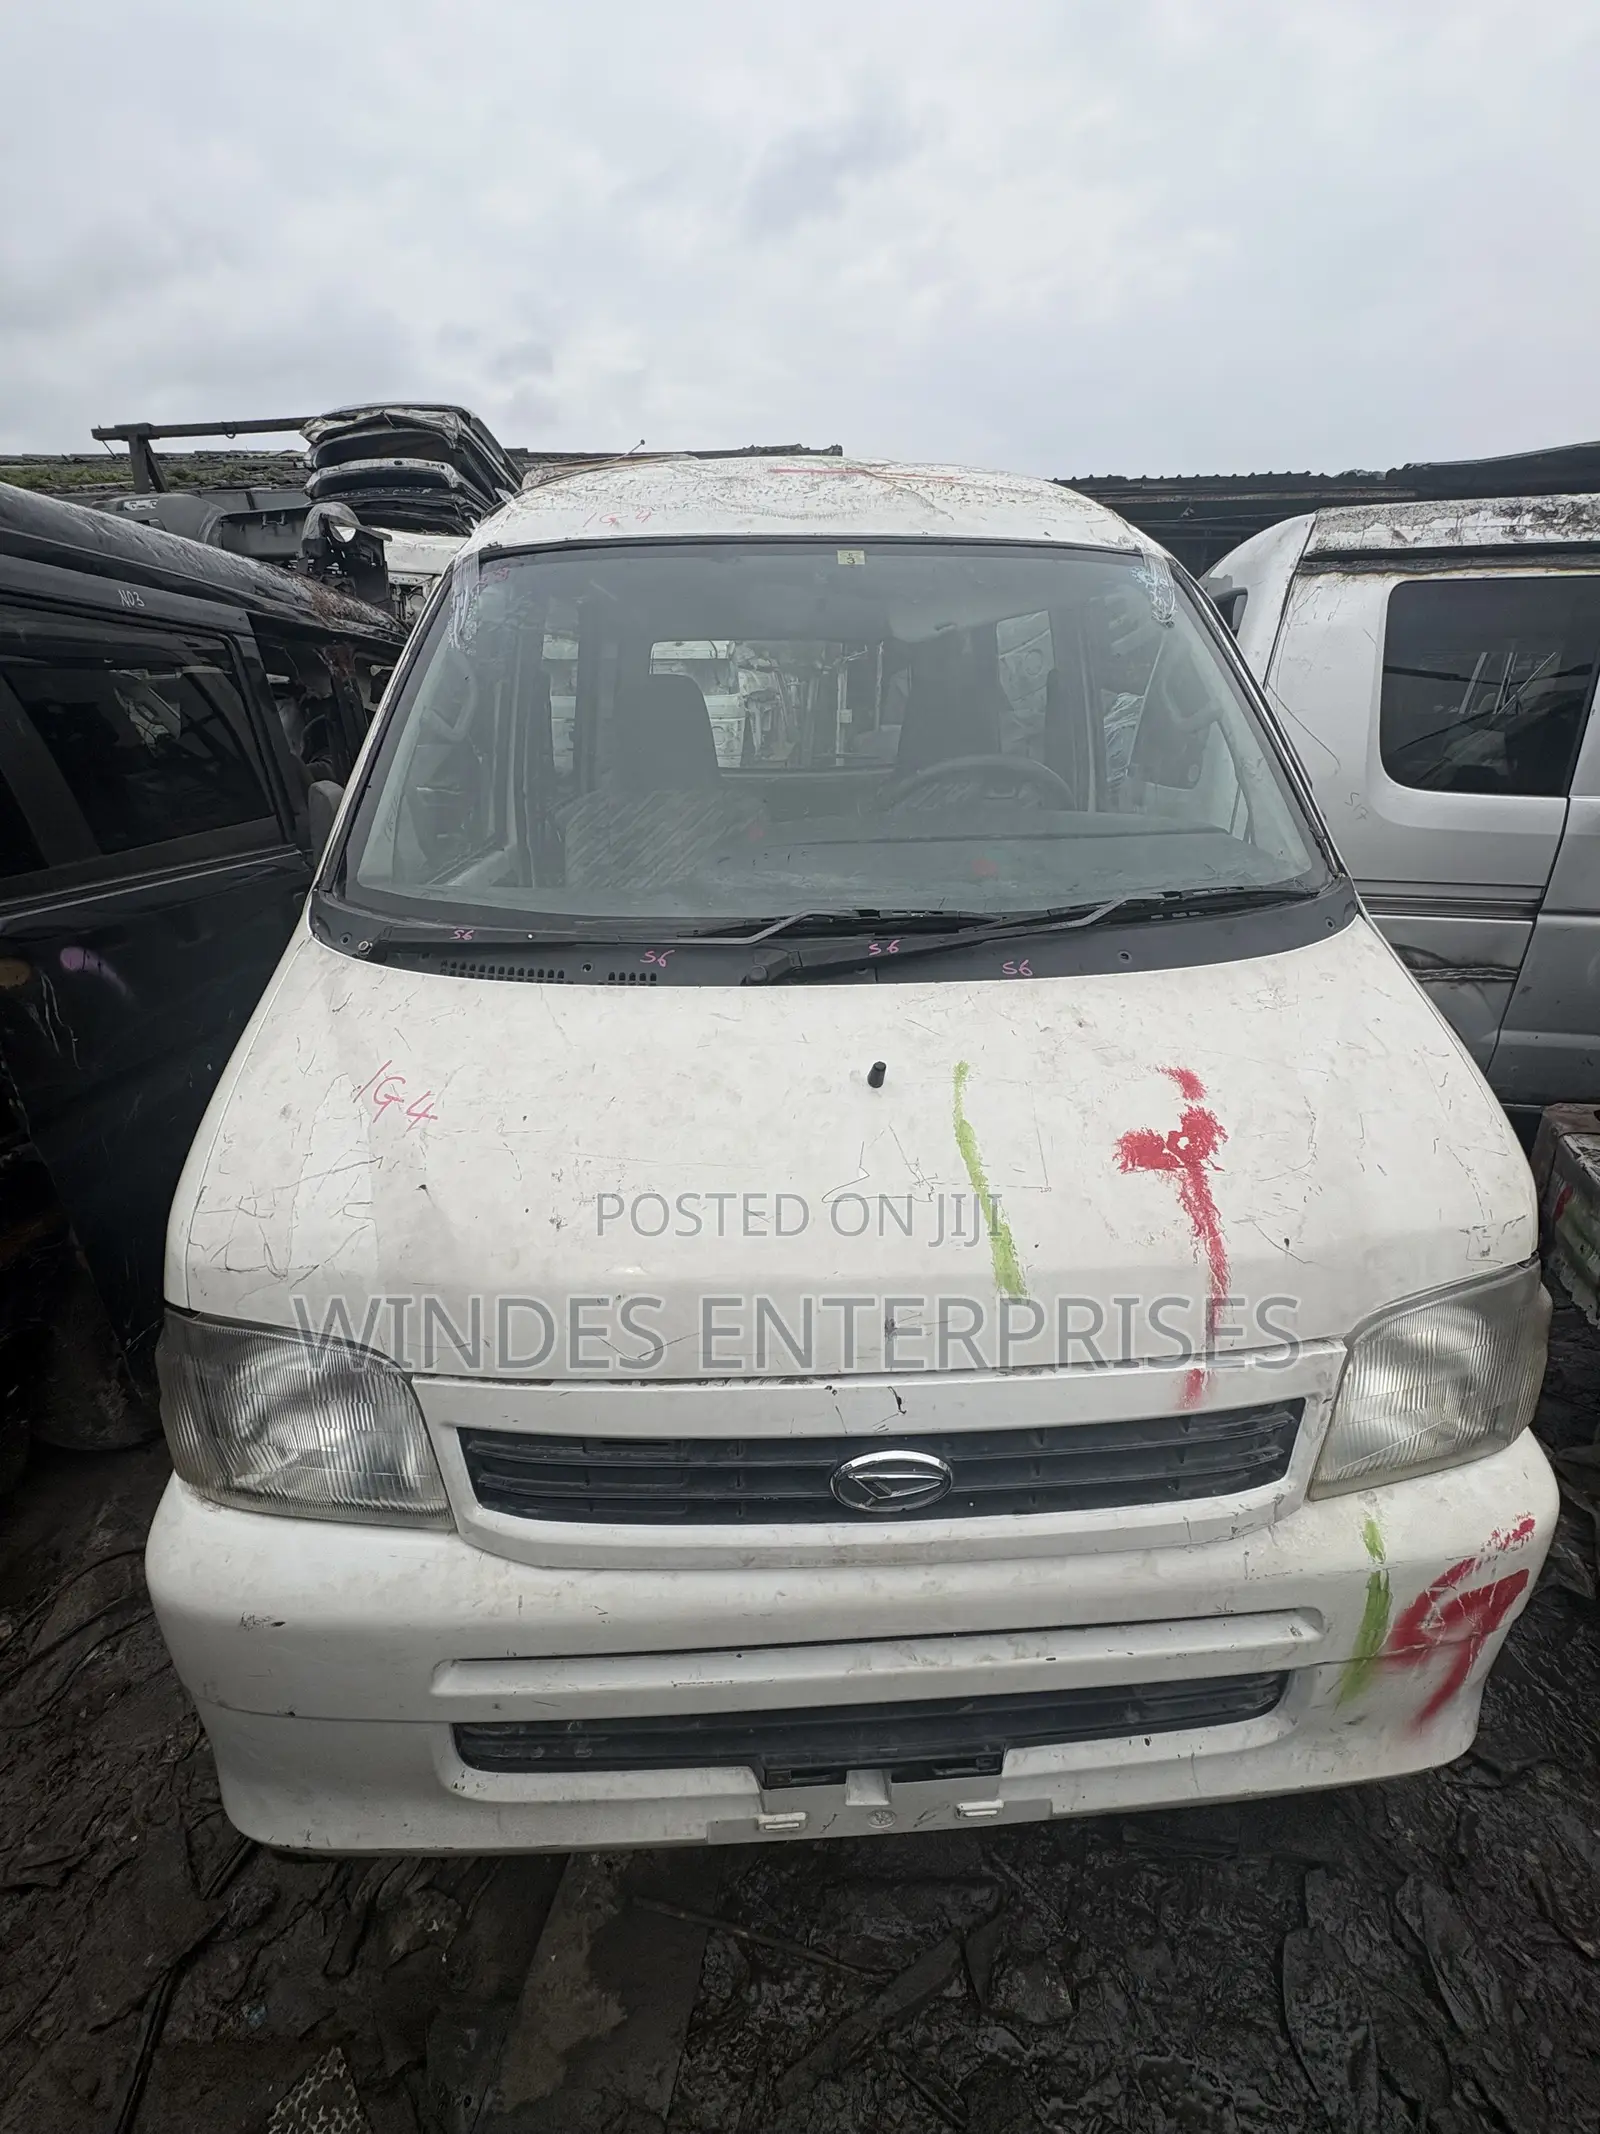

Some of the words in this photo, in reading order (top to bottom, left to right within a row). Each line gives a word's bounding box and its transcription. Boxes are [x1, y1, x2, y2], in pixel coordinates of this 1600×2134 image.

[869, 939, 901, 957] S6
[640, 949, 676, 968] S6
[1002, 959, 1034, 977] S6
